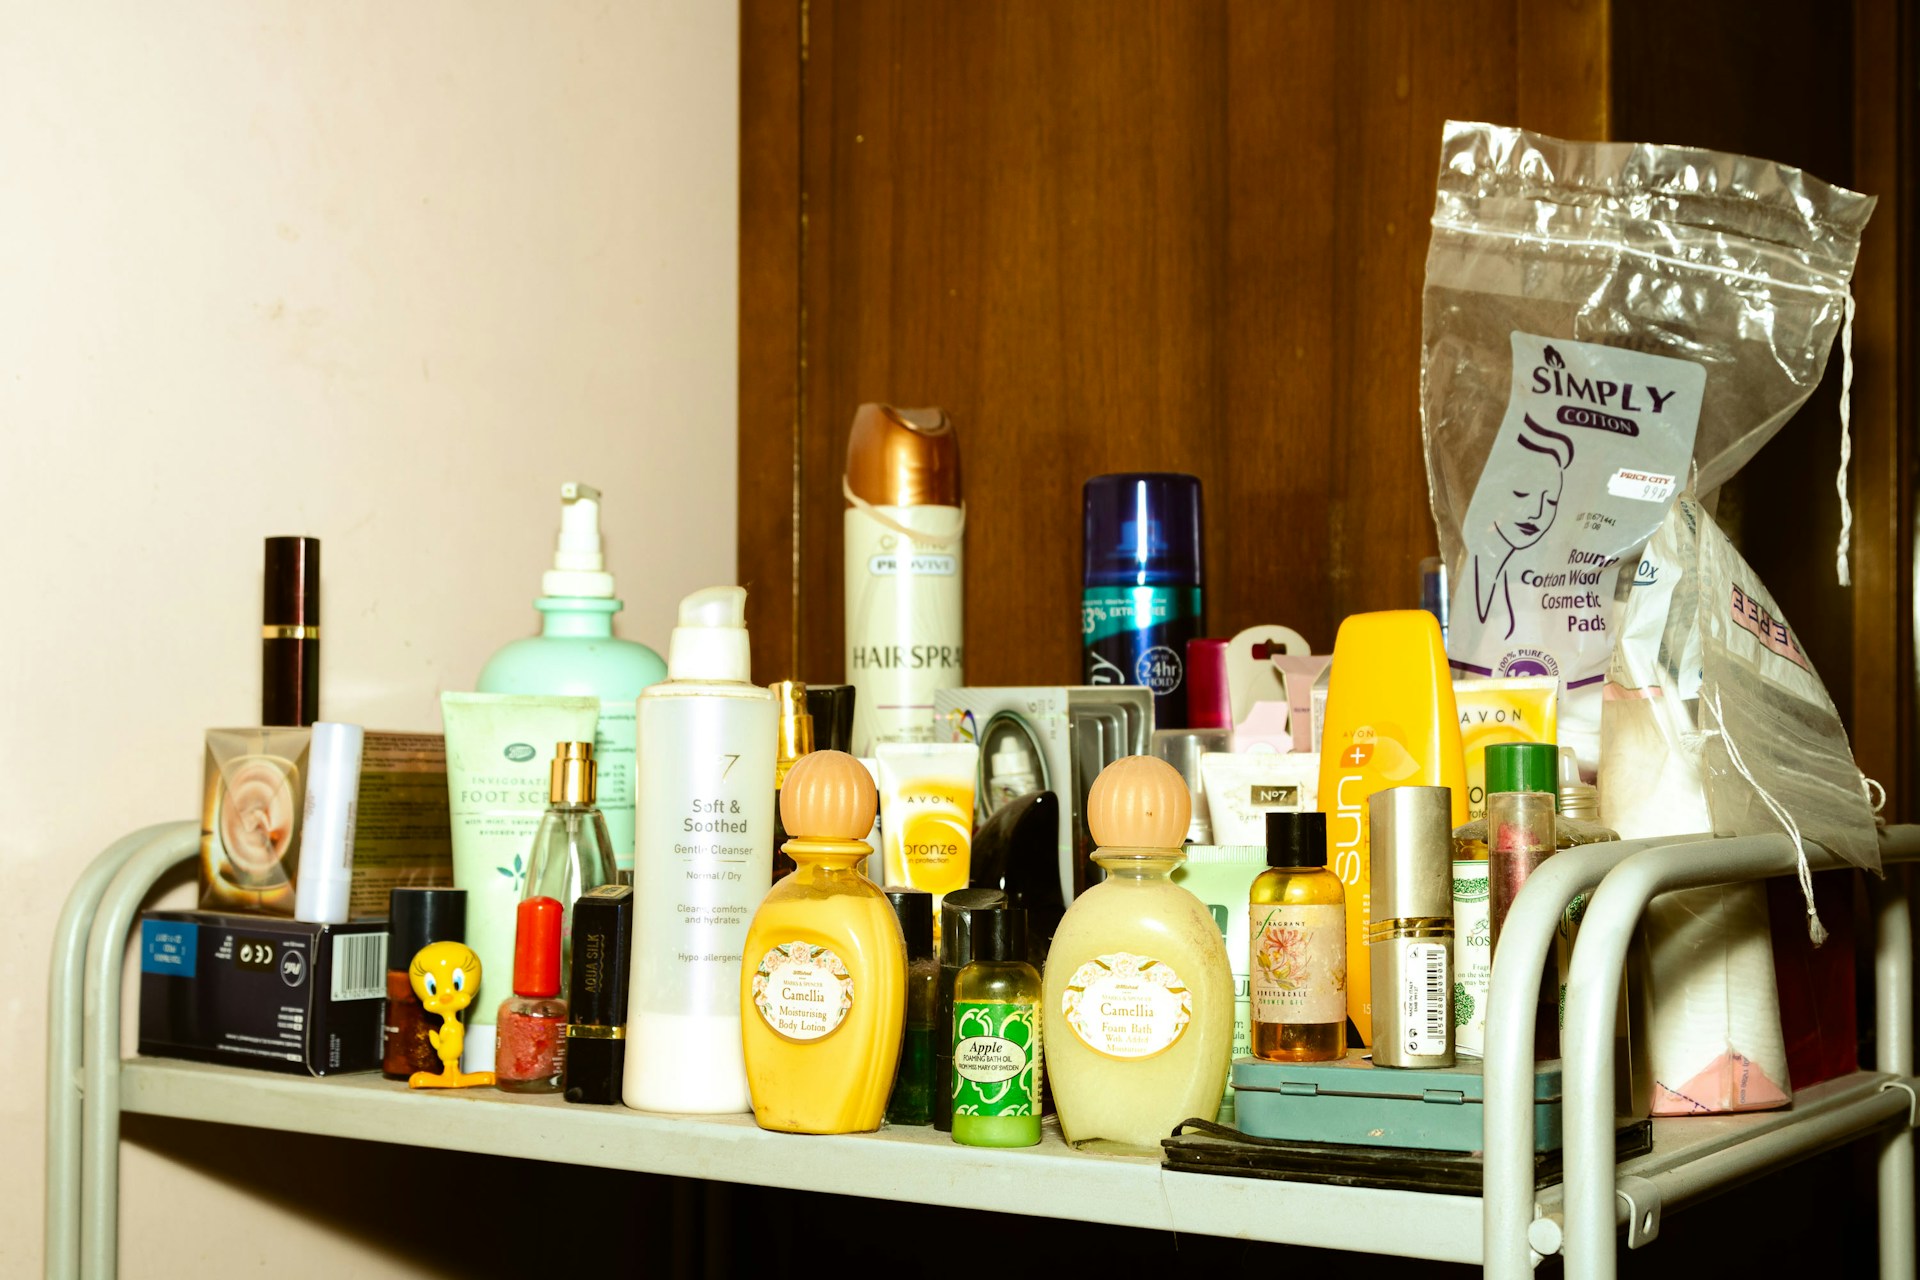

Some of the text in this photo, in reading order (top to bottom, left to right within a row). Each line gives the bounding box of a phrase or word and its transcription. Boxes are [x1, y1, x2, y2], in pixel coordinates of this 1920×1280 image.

[1532, 366, 1676, 413] SIMPLY
[1564, 409, 1632, 433] COTTON
[1620, 472, 1670, 485] PRICE CITY
[1521, 569, 1566, 588] Cotton
[1541, 591, 1603, 610] Cosmetic
[1110, 606, 1137, 617] EXTR
[1568, 615, 1606, 632] Pads
[1143, 661, 1177, 677] 24hr
[1499, 651, 1517, 672] 100%
[1518, 649, 1543, 657] PURE
[1543, 654, 1560, 677] COTTO
[1147, 677, 1174, 686] HOLD
[1461, 709, 1522, 724] AVON
[1343, 730, 1374, 738] AVON
[461, 791, 509, 803] FOOT
[908, 796, 954, 804] AVON
[692, 799, 740, 814] Soft &
[684, 818, 748, 834] Soothed
[711, 845, 754, 856] Cleanser
[915, 857, 950, 865] protection
[727, 872, 742, 882] Dry
[712, 905, 748, 914] comforts
[684, 916, 740, 926] and hydrates
[585, 933, 600, 993] AQUA SILK
[1467, 971, 1478, 979] the
[782, 988, 824, 1002] Camellia
[779, 1006, 827, 1021] Moisturising
[1100, 1003, 1154, 1017] Camellia
[779, 1019, 826, 1033] Body Lotion
[1102, 1022, 1152, 1034] Foam Bath
[970, 1041, 1003, 1055] Apple
